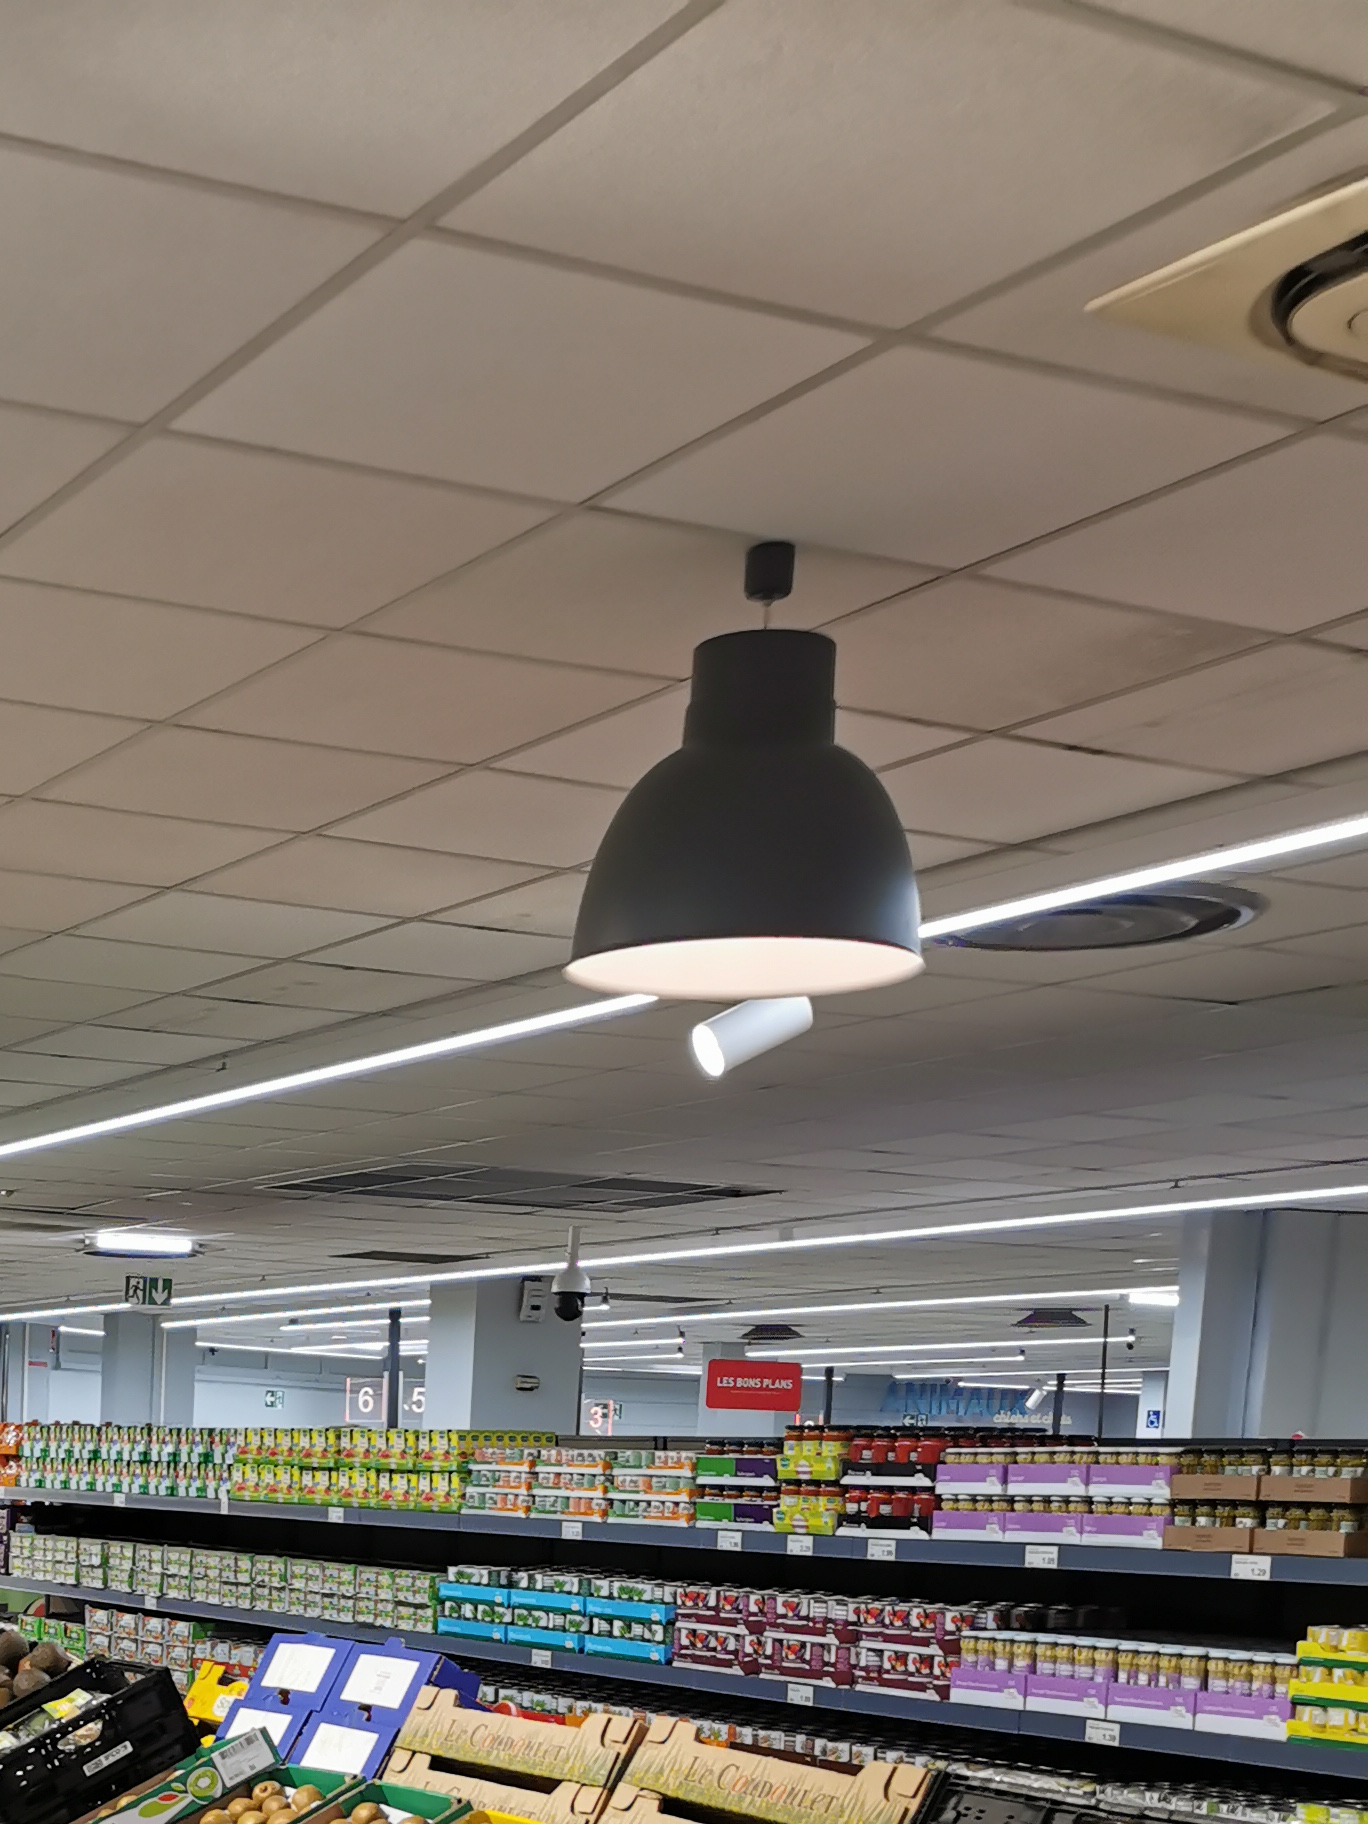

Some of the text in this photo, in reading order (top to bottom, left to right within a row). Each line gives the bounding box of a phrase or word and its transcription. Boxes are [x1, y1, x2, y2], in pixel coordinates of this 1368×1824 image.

[716, 1376, 734, 1387] LES
[736, 1377, 761, 1389] BONS
[358, 1386, 374, 1413] 6
[411, 1387, 426, 1413] 5
[589, 1406, 602, 1428] 3
[1044, 1412, 1072, 1425] chts
